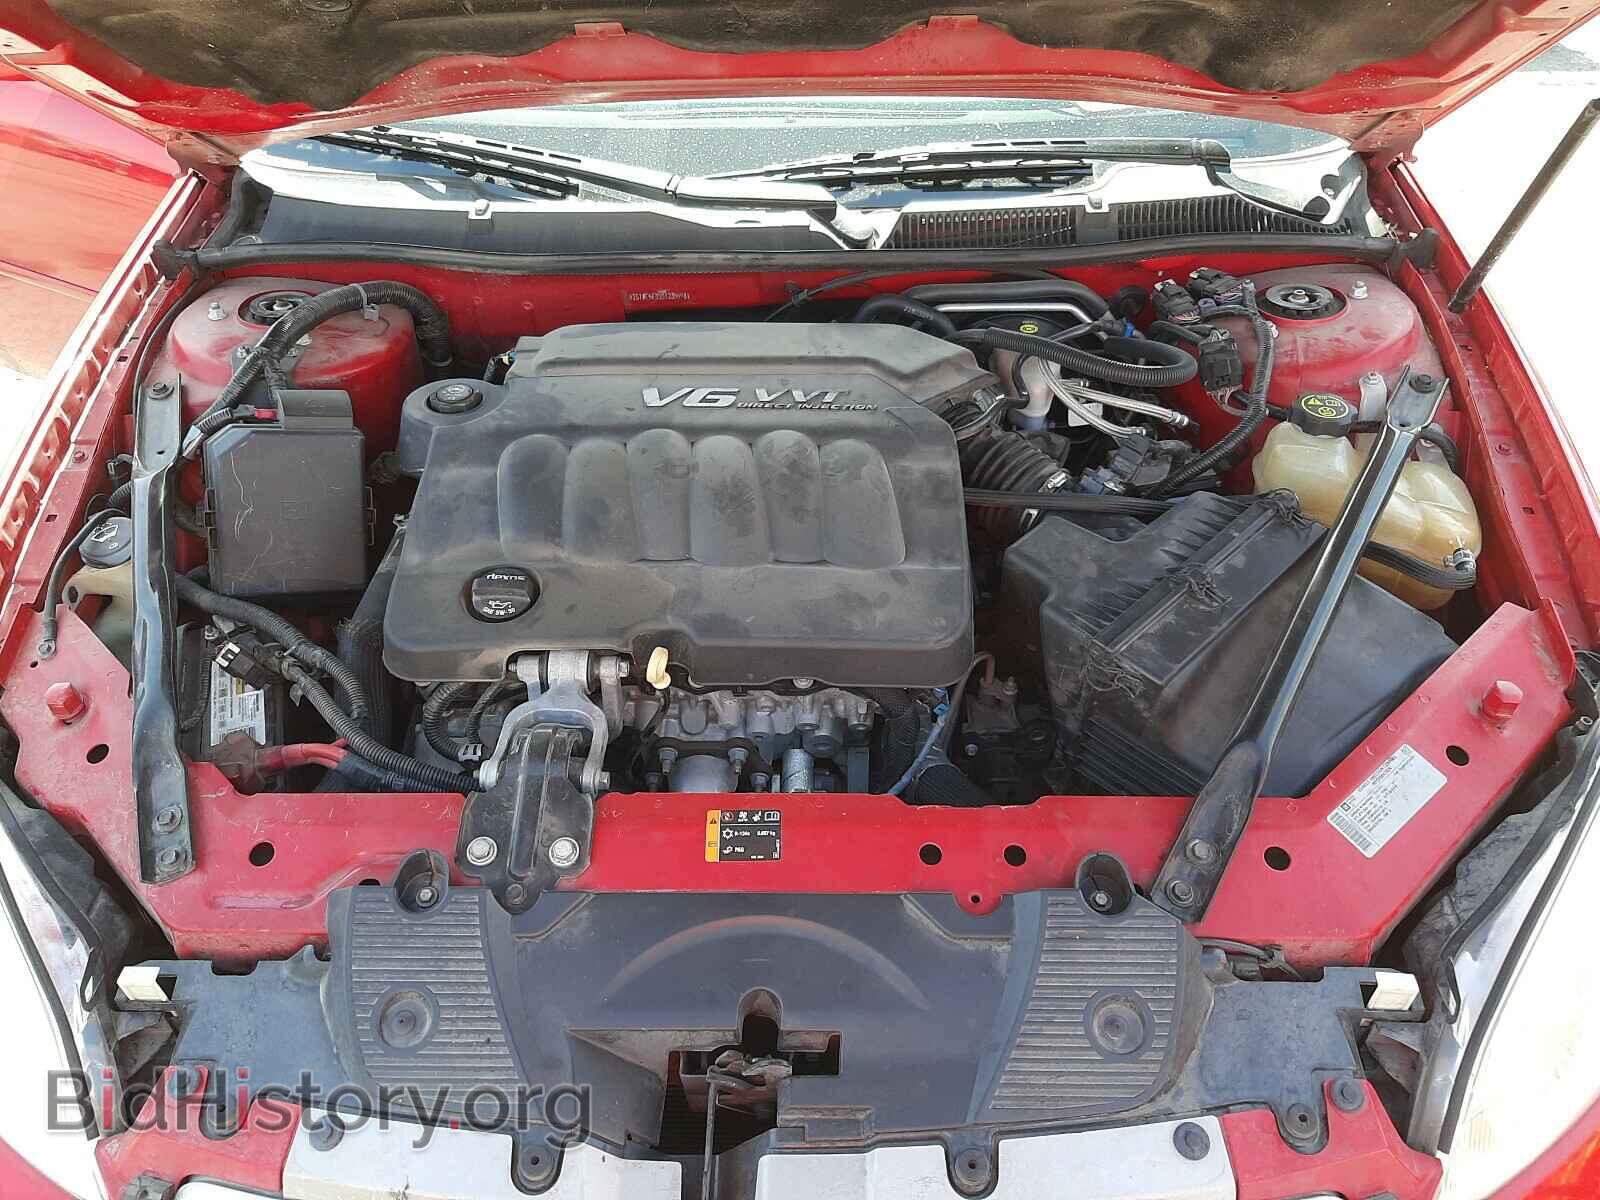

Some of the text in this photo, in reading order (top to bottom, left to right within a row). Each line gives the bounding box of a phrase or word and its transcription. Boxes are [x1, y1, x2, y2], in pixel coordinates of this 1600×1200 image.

[642, 387, 851, 407] V6 VVT
[737, 401, 878, 410] DIRECT INJECTION
